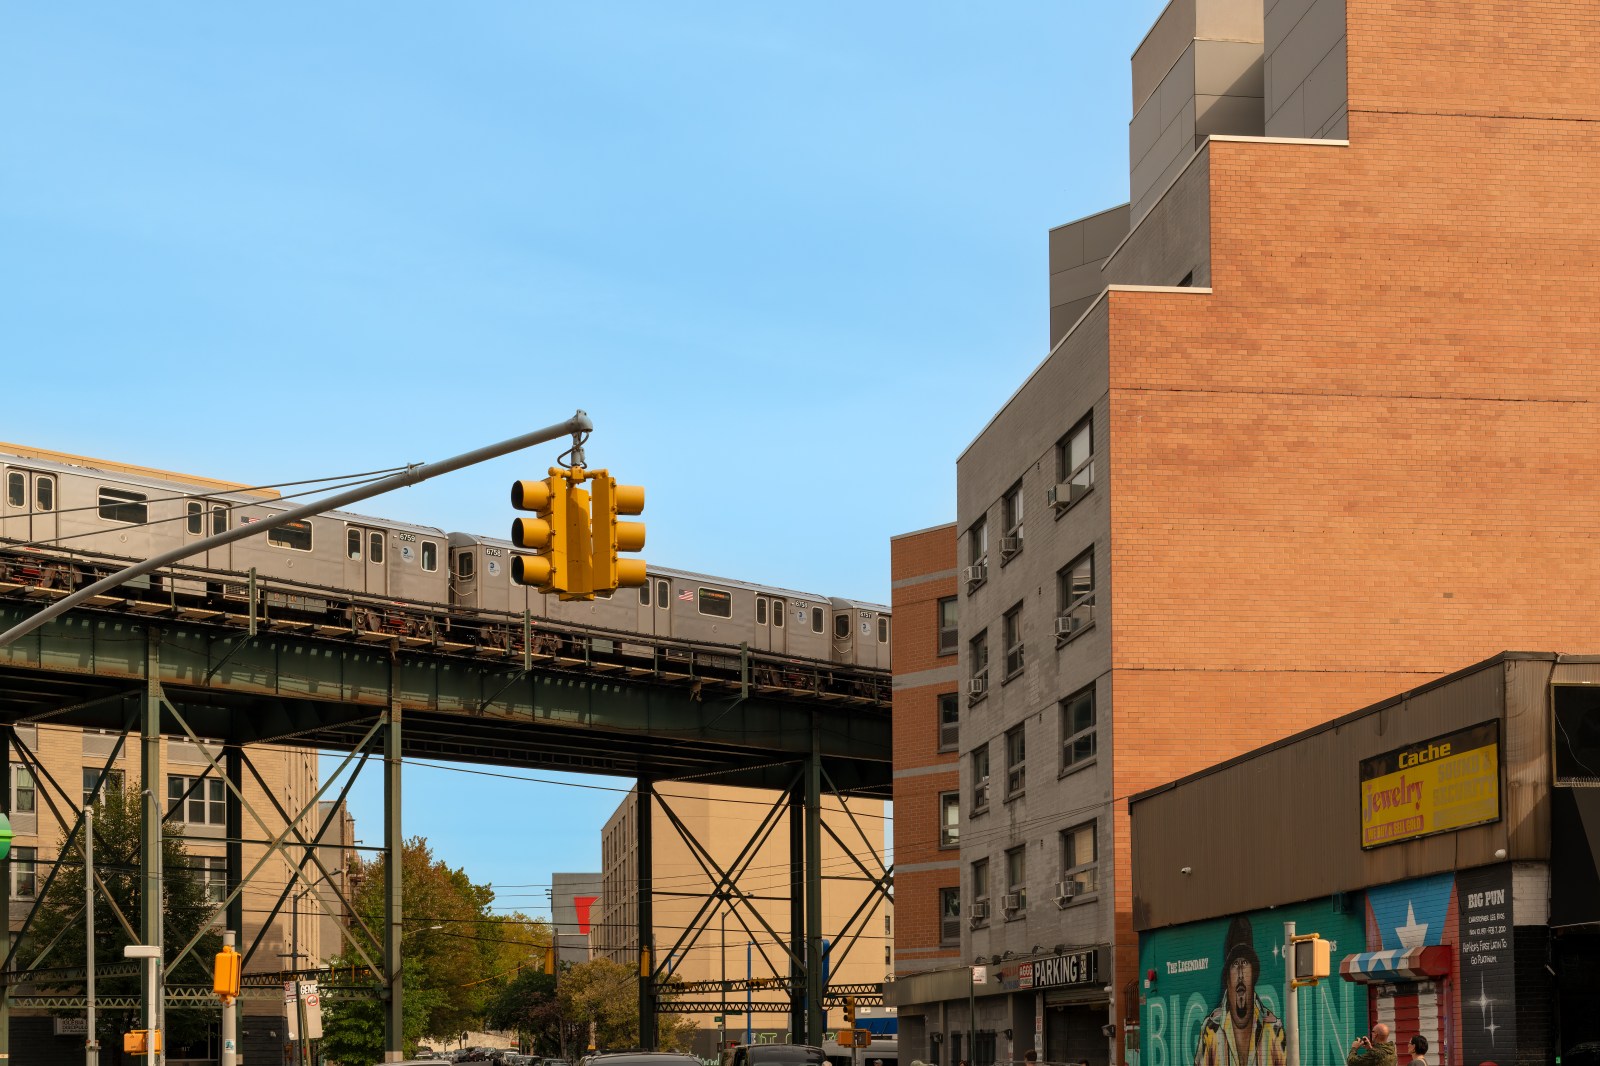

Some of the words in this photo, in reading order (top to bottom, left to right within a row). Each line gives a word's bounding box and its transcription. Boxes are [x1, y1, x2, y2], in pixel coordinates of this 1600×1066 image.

[1398, 742, 1451, 769] Cache
[1363, 774, 1424, 823] jewelry
[1467, 892, 1484, 909] BIG
[1485, 889, 1505, 906] PUN
[1034, 955, 1078, 987] PARKING
[1166, 961, 1177, 975] THE
[1177, 957, 1209, 973] LEGENDARY
[300, 984, 318, 995] GENIE
